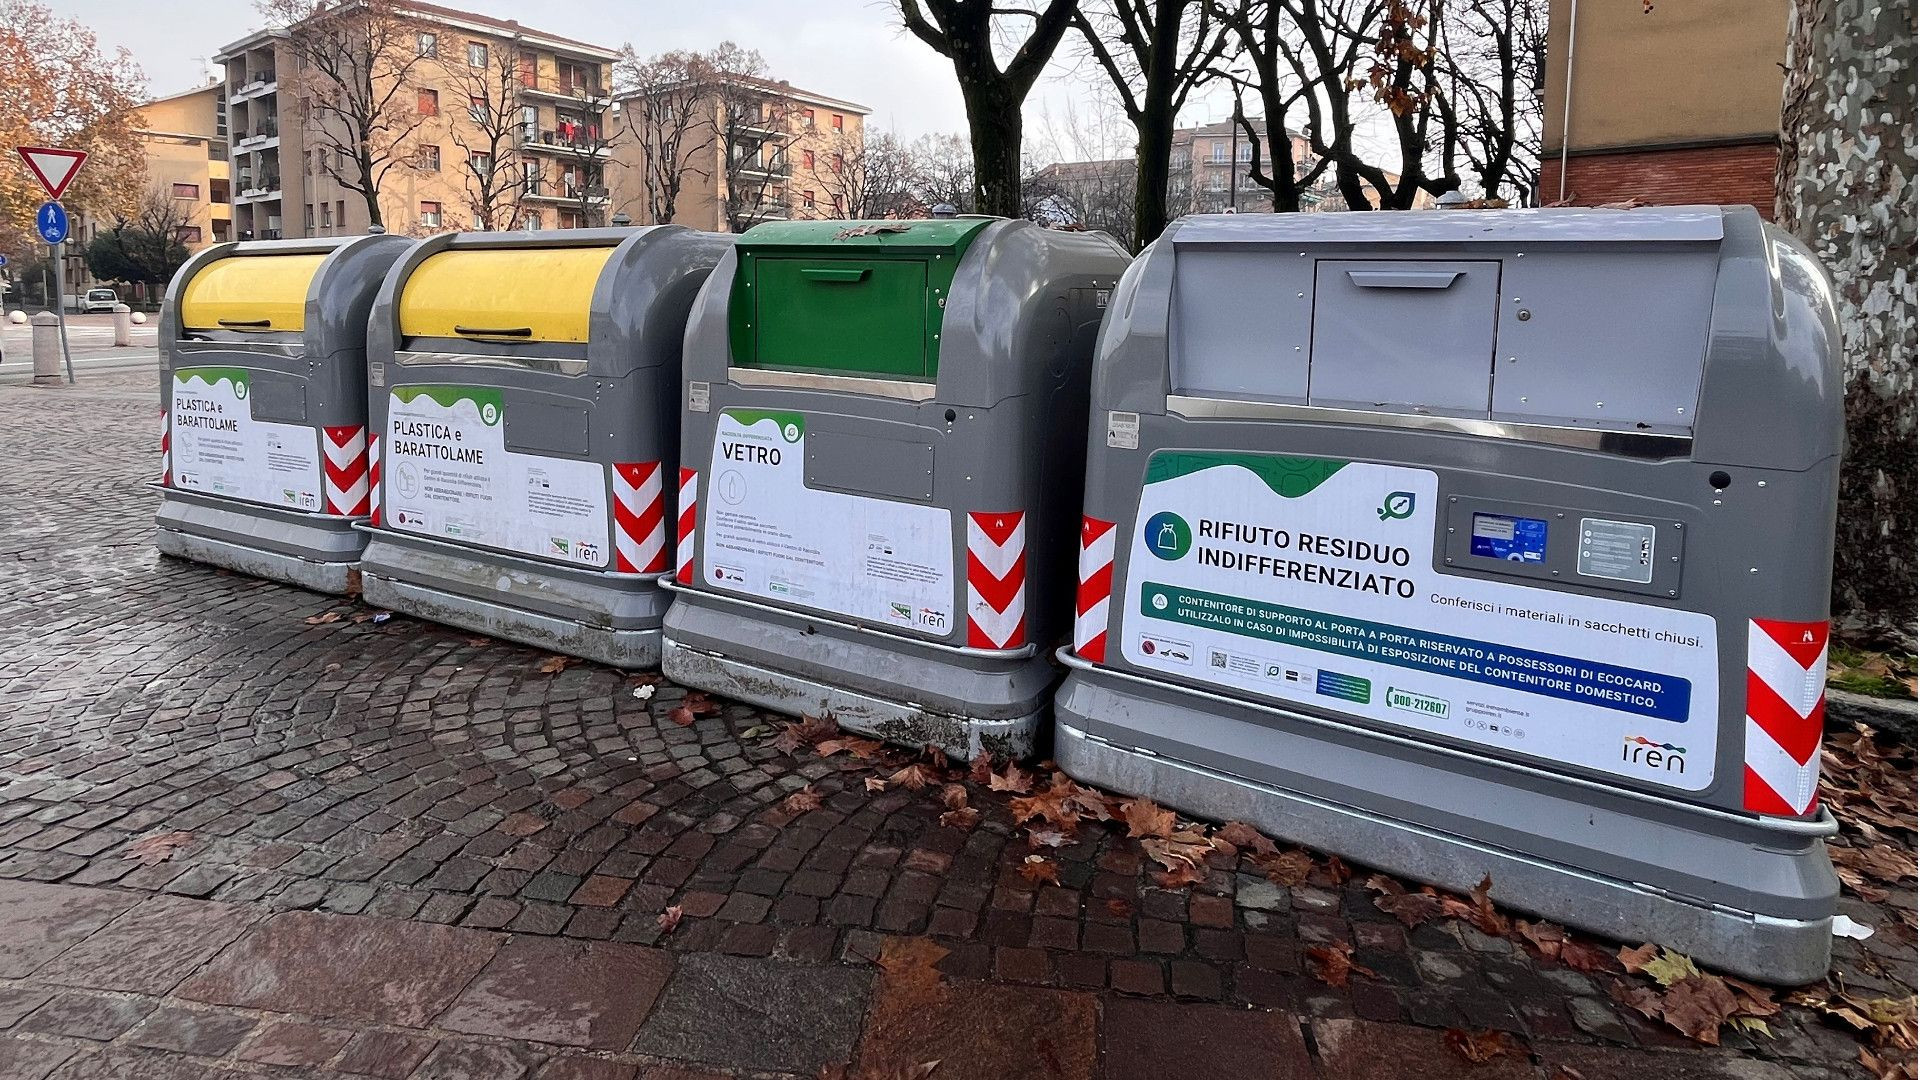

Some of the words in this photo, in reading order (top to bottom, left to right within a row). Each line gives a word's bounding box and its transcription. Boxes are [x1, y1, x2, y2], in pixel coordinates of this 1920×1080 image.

[176, 398, 216, 413] PLASTICA
[218, 405, 223, 413] e
[177, 414, 238, 432] BARATTOLAME
[394, 420, 451, 441] PLASTICA
[454, 430, 462, 441] e
[394, 440, 484, 465] BARATTOLAME
[722, 442, 781, 466] VETRO
[300, 495, 315, 508] iren
[576, 547, 598, 561] iren
[1199, 519, 1290, 549] RIFIUTO
[1299, 533, 1410, 567] RESIDUO
[1198, 546, 1415, 598] INDIFFERENZIATO
[919, 612, 945, 628] iren
[1430, 593, 1495, 613] Conferisci
[1505, 605, 1564, 625] materiali
[1568, 614, 1580, 627] in
[1584, 620, 1650, 639] sacchetti
[1654, 630, 1704, 648] chiusi.
[1178, 595, 1244, 614] CONTENITORE
[1246, 608, 1256, 616] DI
[1259, 610, 1312, 627] SUPPORTO
[1314, 620, 1328, 630] AL
[1331, 622, 1366, 638] PORTA
[1368, 630, 1376, 639] A
[1380, 632, 1416, 647] PORTA
[1420, 639, 1484, 660] RISERVATO
[1487, 652, 1496, 662] A
[1498, 654, 1576, 676] POSSESSORI
[1580, 669, 1593, 680] DI
[1598, 672, 1665, 694] ECOCARD.
[1178, 608, 1231, 625] UTILIZZALO
[1234, 618, 1244, 628] IN
[1246, 622, 1273, 634] CASO
[1276, 626, 1286, 636] DI
[1288, 629, 1364, 652] IMPOSSIBILITÀ
[1368, 644, 1378, 654] DI
[1382, 646, 1456, 669] ESPOSIZIONE
[1459, 661, 1481, 674] DEL
[1484, 666, 1572, 692] CONTENITORE
[1576, 684, 1658, 709] DOMESTICO.
[1394, 694, 1447, 714] 800-212607
[1622, 744, 1686, 774] iren
